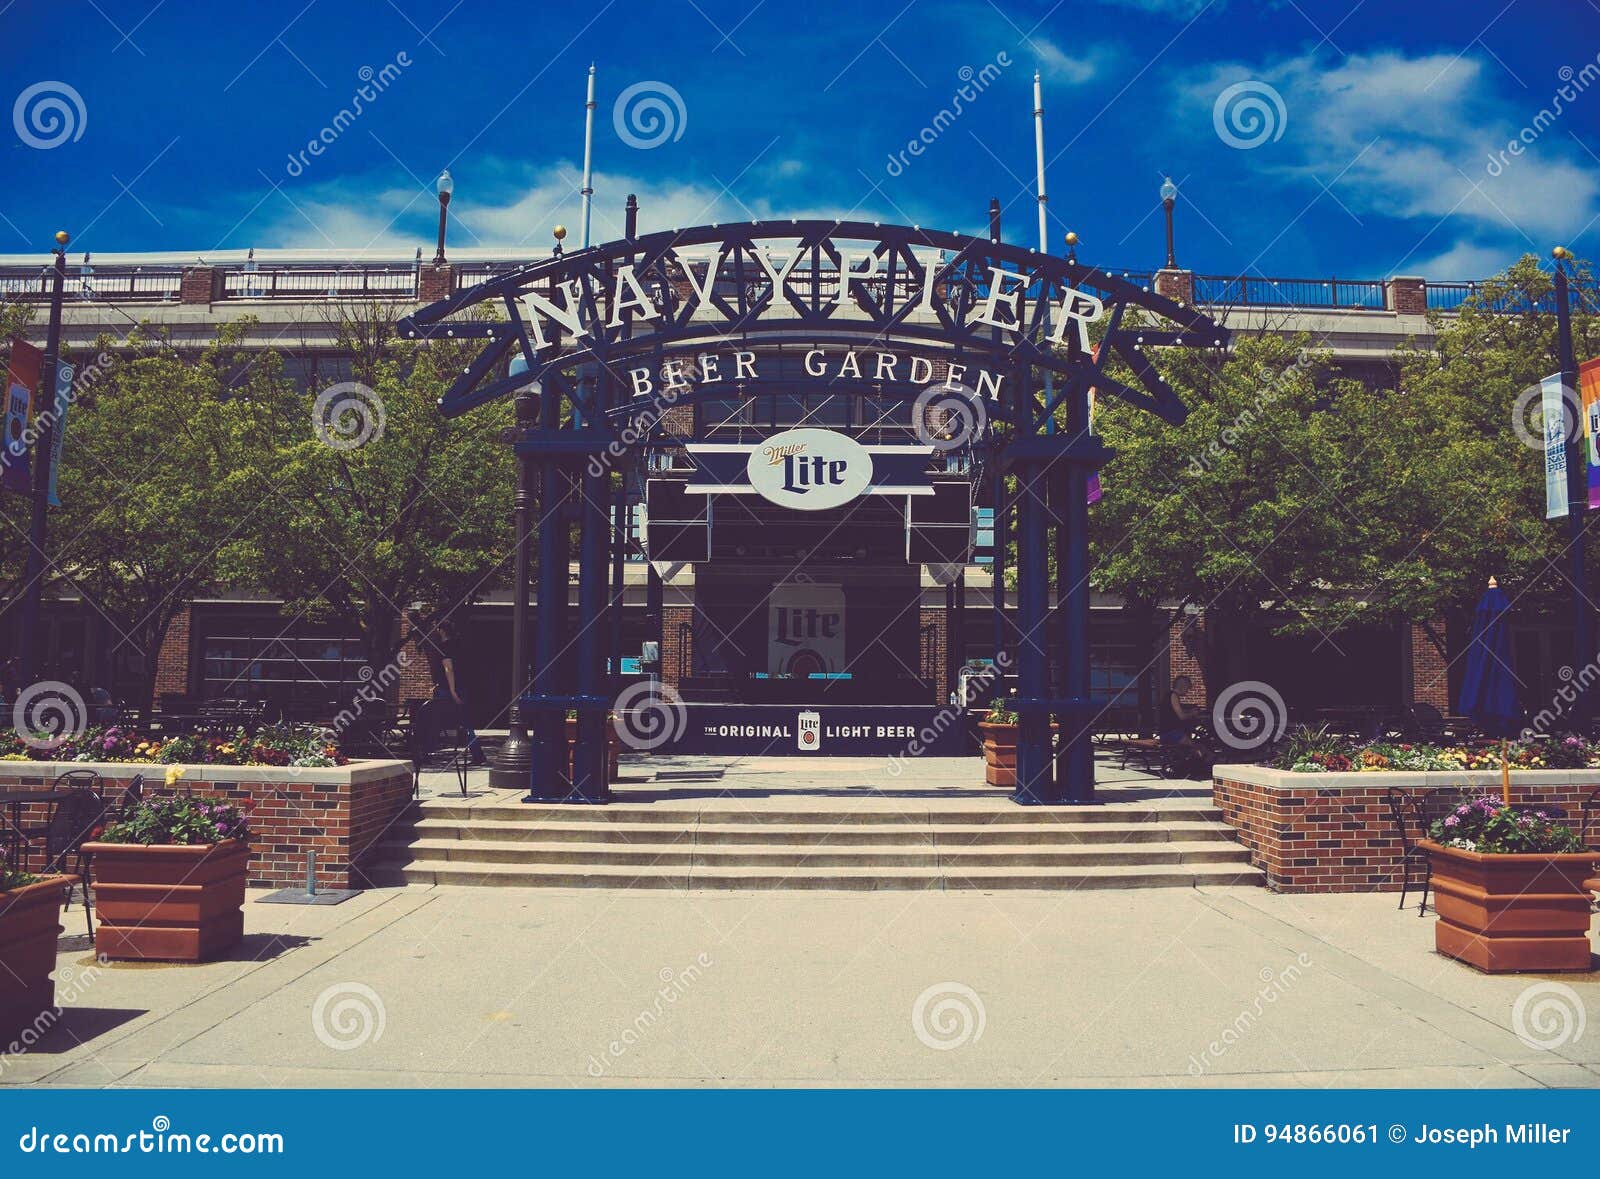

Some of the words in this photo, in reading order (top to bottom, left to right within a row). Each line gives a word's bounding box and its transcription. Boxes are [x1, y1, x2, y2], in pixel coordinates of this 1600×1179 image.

[627, 350, 759, 398] BEER
[804, 348, 1006, 402] GARDEN
[763, 442, 808, 466] Miller
[781, 454, 848, 495] Lite
[774, 606, 841, 647] Lite
[719, 725, 792, 738] ORIGINAL
[800, 718, 819, 731] Lite
[826, 726, 871, 738] LIGHT
[876, 726, 916, 738] BEER
